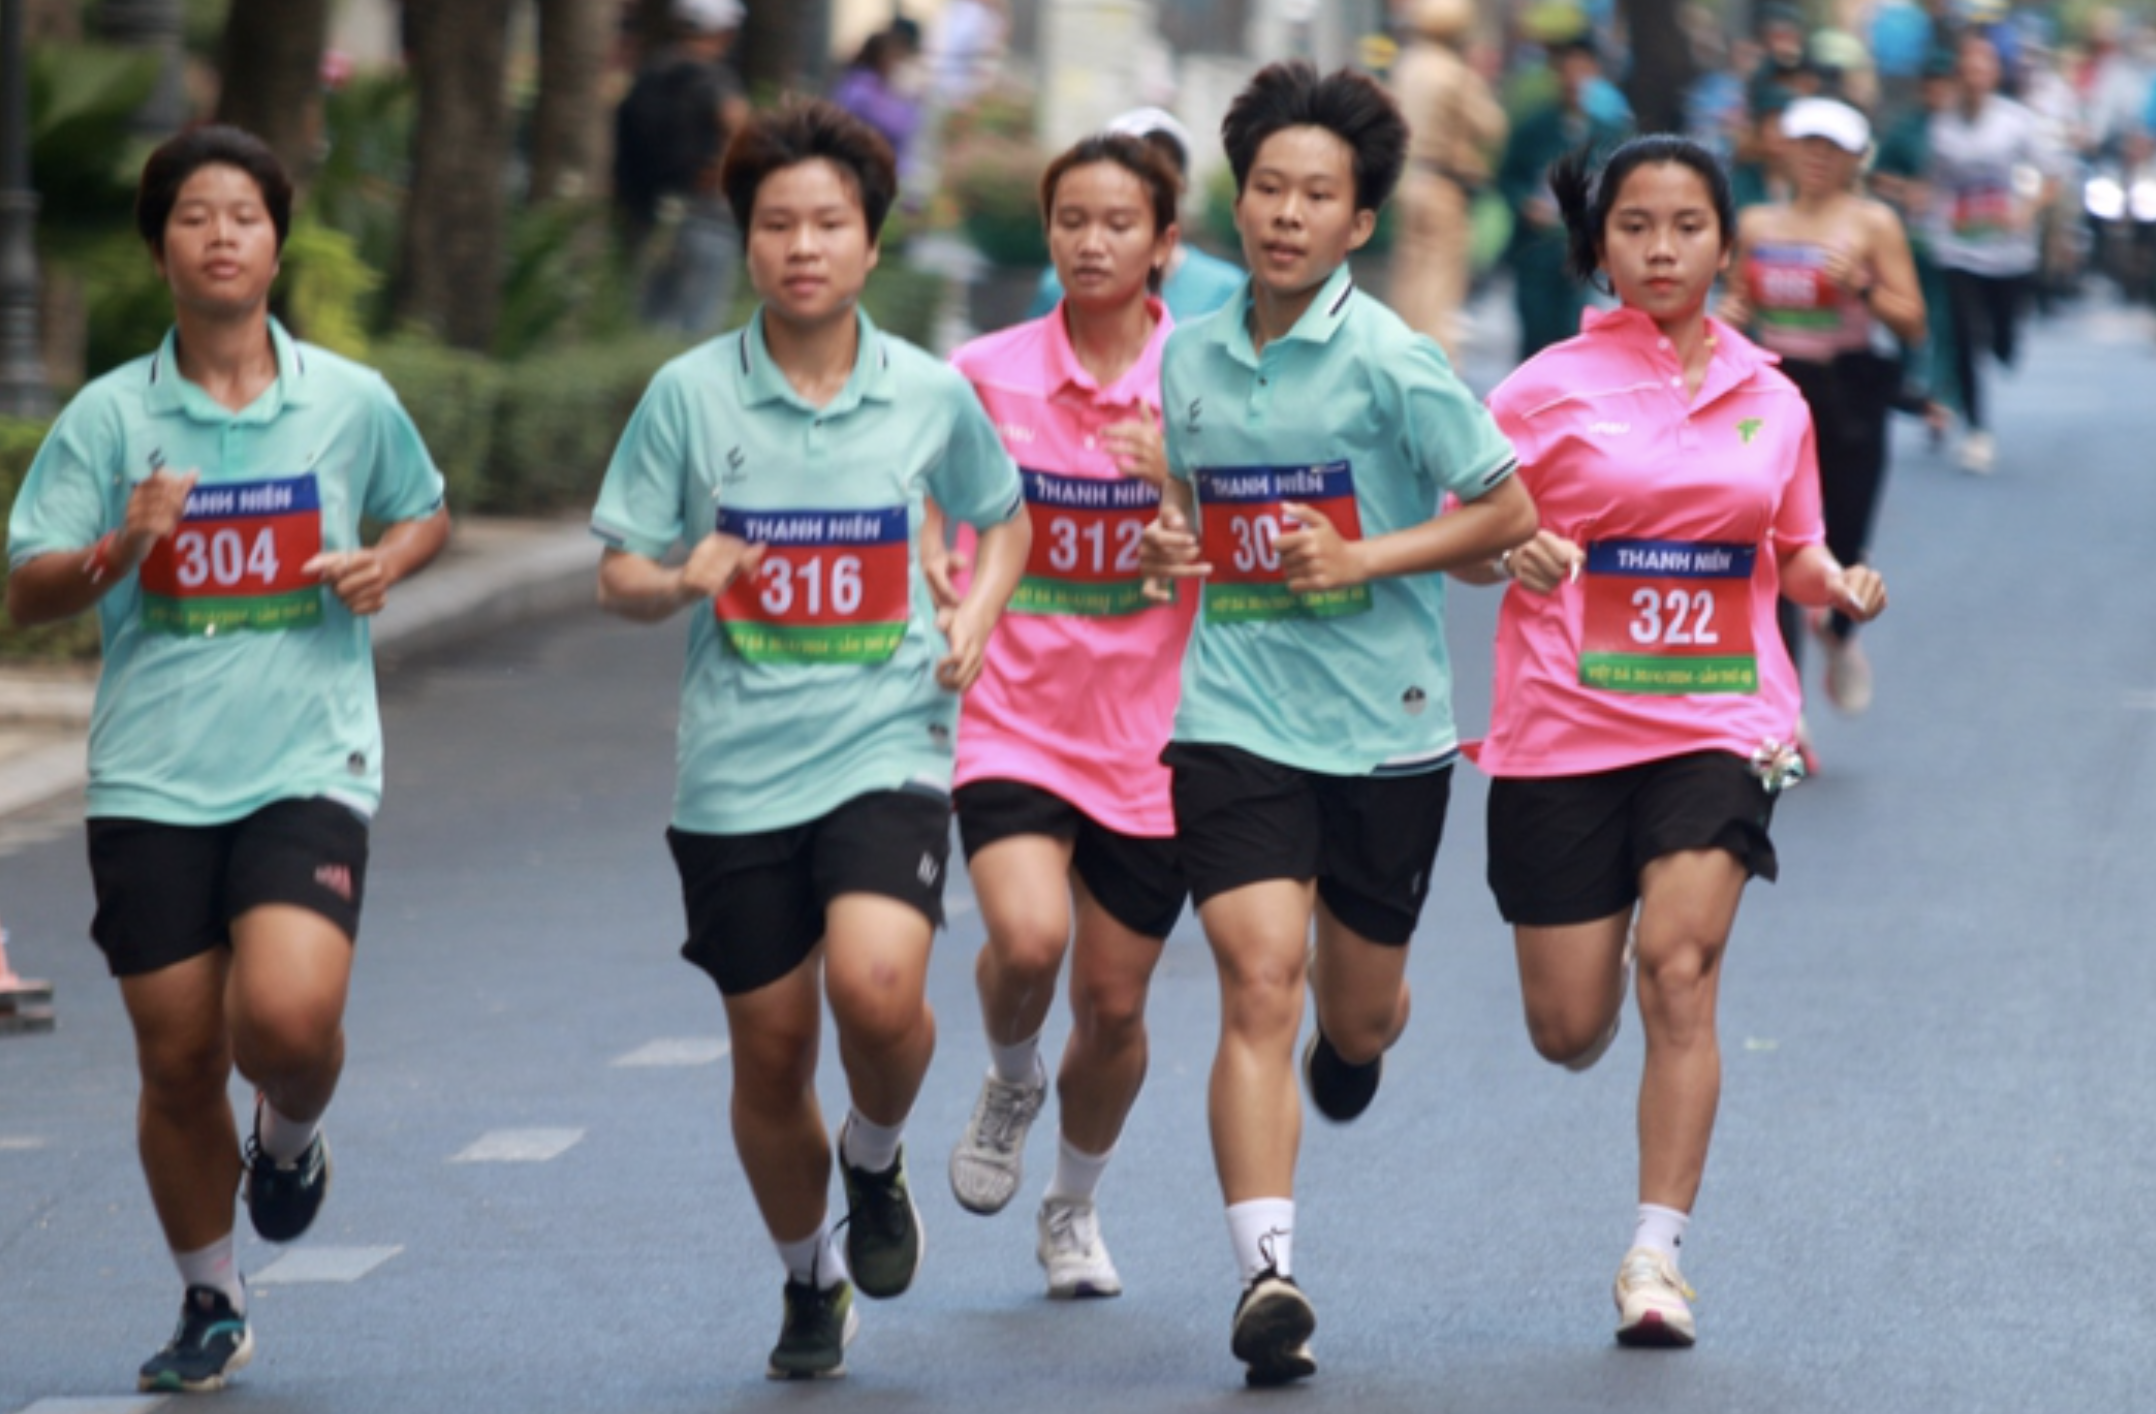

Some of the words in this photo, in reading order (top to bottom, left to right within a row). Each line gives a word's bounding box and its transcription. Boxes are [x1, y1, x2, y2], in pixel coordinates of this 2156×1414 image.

[184, 490, 235, 517] ANH
[1035, 474, 1108, 504] THANH
[1211, 474, 1270, 496] THANH
[1274, 469, 1325, 493] NIÊN
[744, 517, 823, 541] THANH
[827, 512, 881, 539] NIÊN
[1048, 515, 1144, 574] 312
[1231, 512, 1305, 573] 30
[176, 526, 280, 588] 304
[1617, 548, 1691, 572] THANH
[1694, 546, 1733, 573] NIÊN
[760, 553, 863, 616] 316
[1629, 585, 1719, 645] 322
